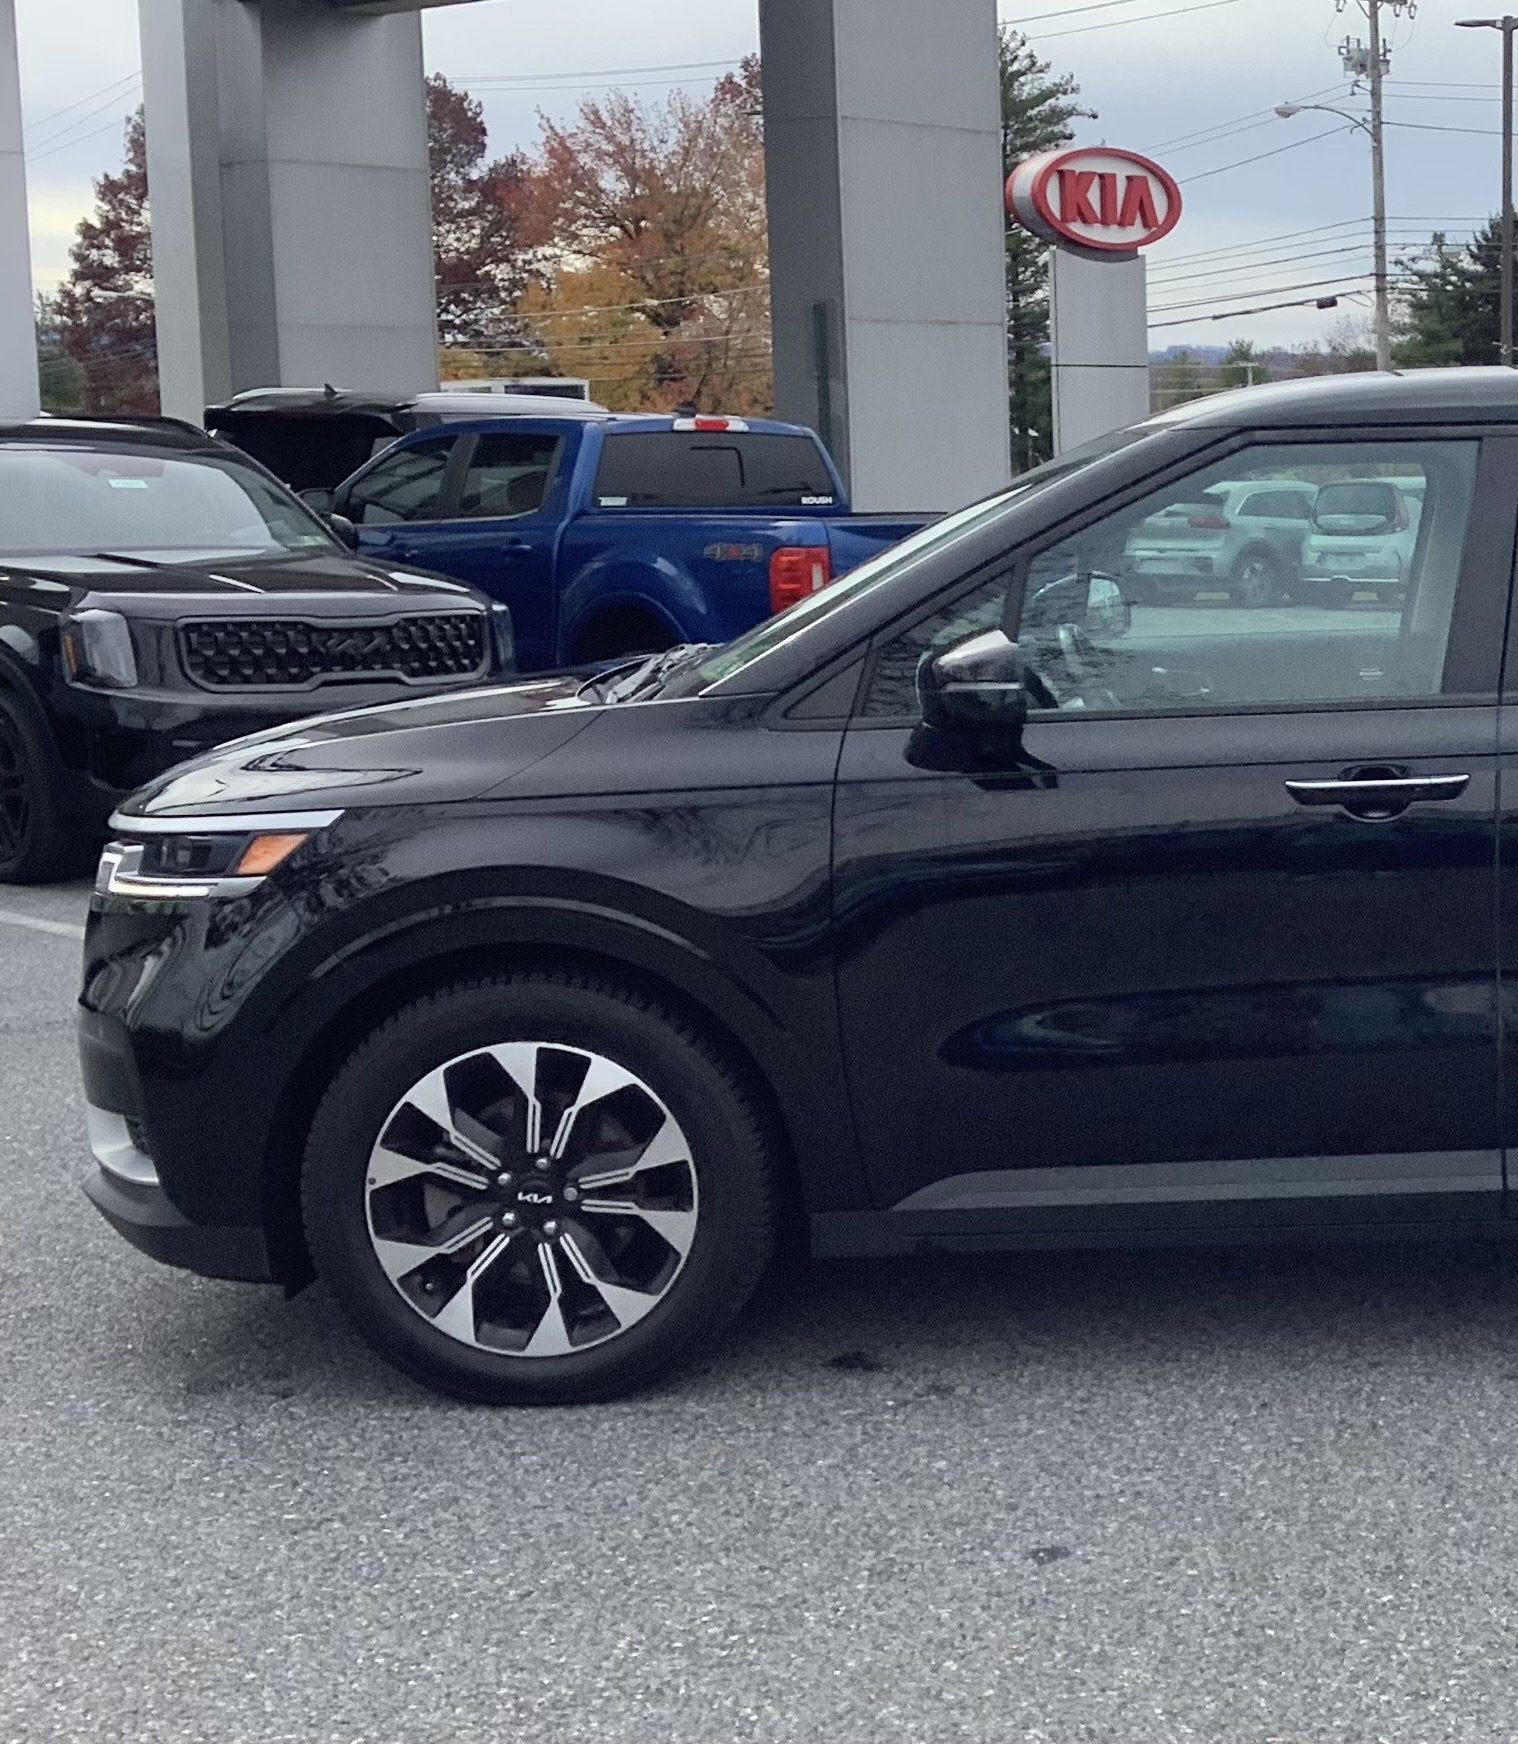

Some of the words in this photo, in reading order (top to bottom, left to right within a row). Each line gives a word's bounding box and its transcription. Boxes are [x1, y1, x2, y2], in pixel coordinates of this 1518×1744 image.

[1057, 169, 1161, 229] KIA
[801, 496, 833, 505] ROUSH
[517, 1191, 553, 1204] KIA
